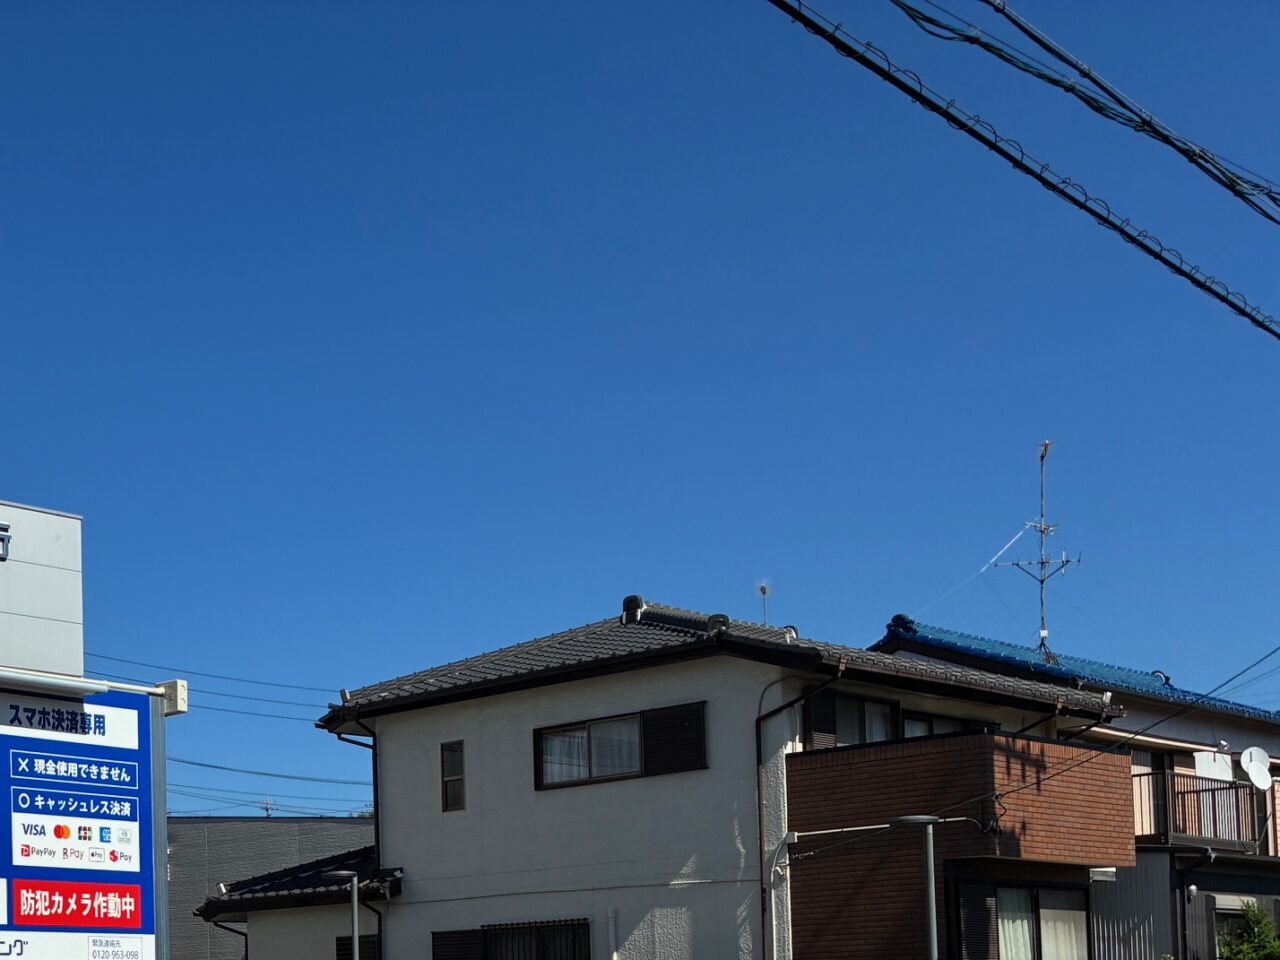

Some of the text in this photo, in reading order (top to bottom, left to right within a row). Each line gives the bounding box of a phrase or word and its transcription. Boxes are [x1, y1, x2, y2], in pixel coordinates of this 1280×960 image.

[9, 703, 107, 737] スマホ決済専用
[33, 758, 132, 783] 現金使用できません
[33, 794, 132, 817] キャッシュレス決済
[21, 823, 47, 837] VISA
[31, 846, 57, 858] PayPay
[19, 888, 136, 920] 防犯カメラ作動中
